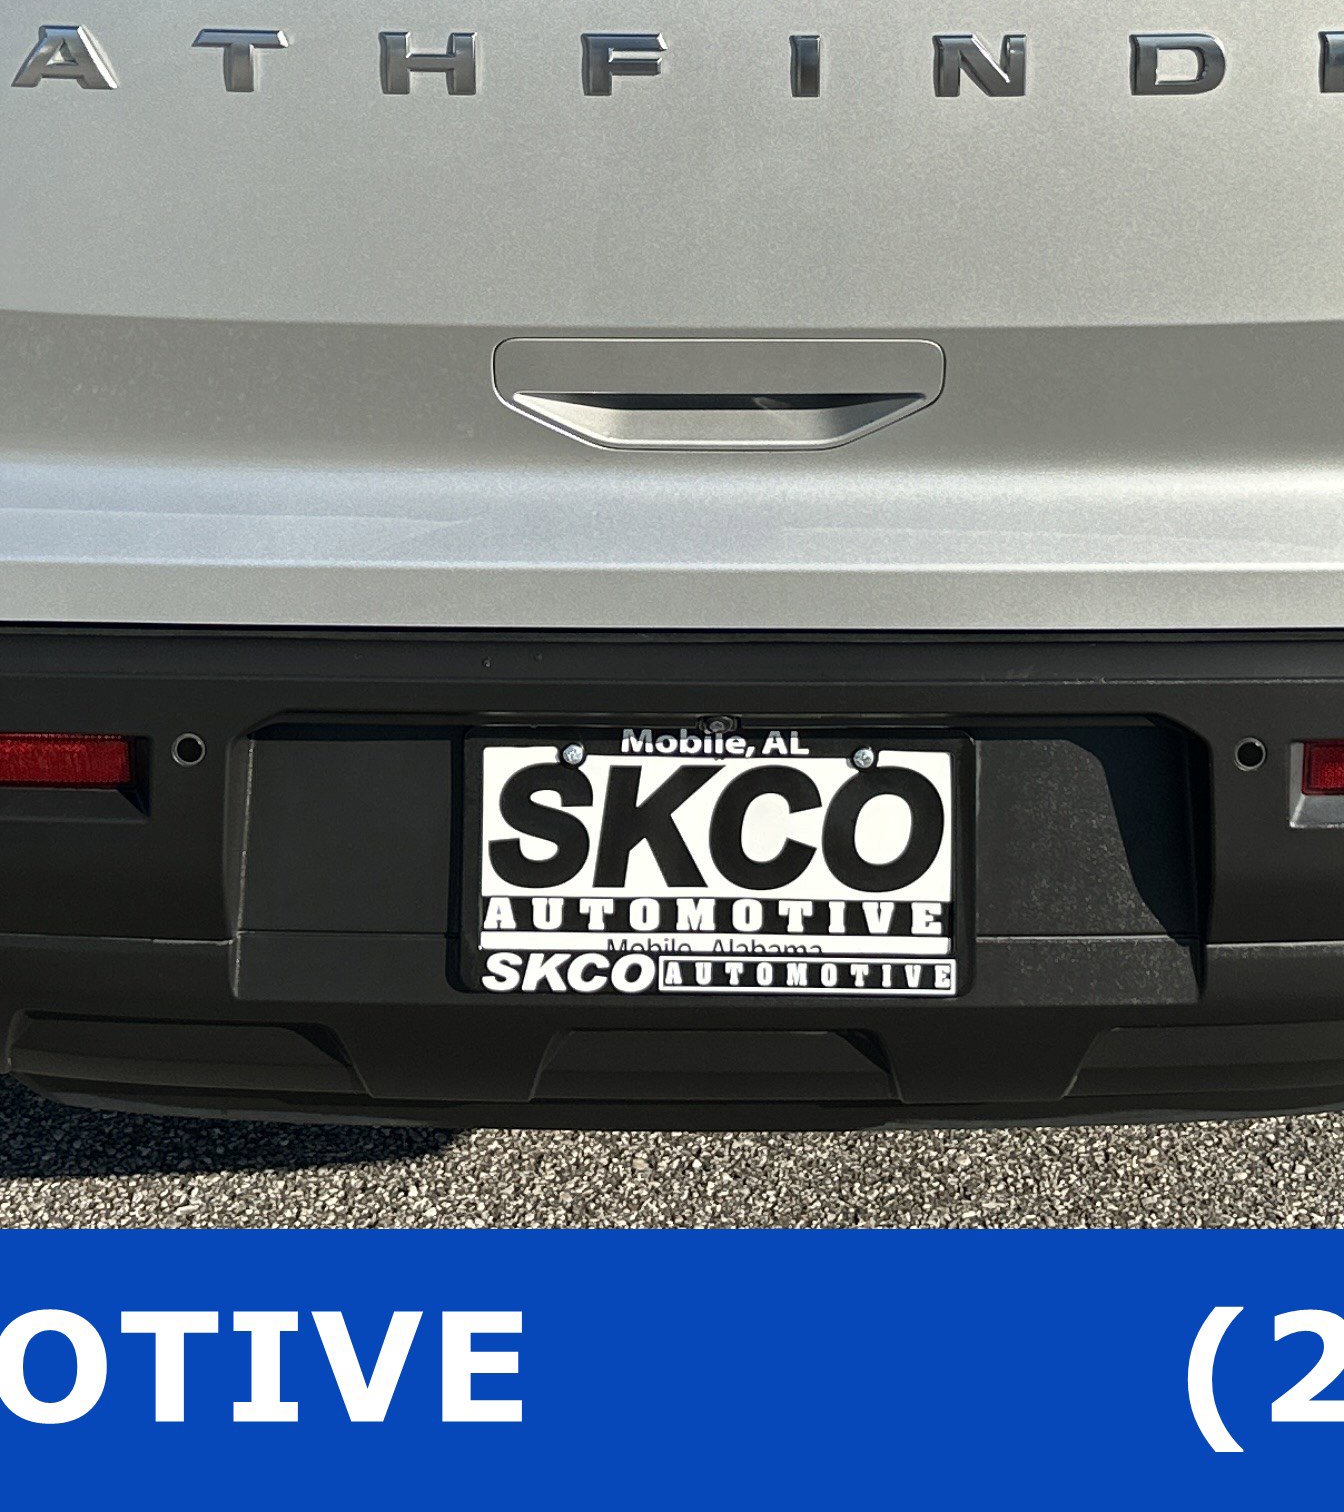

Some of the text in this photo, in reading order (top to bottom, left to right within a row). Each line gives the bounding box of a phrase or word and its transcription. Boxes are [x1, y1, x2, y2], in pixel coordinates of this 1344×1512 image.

[621, 728, 810, 758] Mobile, AL
[488, 762, 945, 893] SKCO
[484, 896, 943, 935] AUTOMOTIVE
[482, 952, 951, 993] SKCO AUTOMOTIVE
